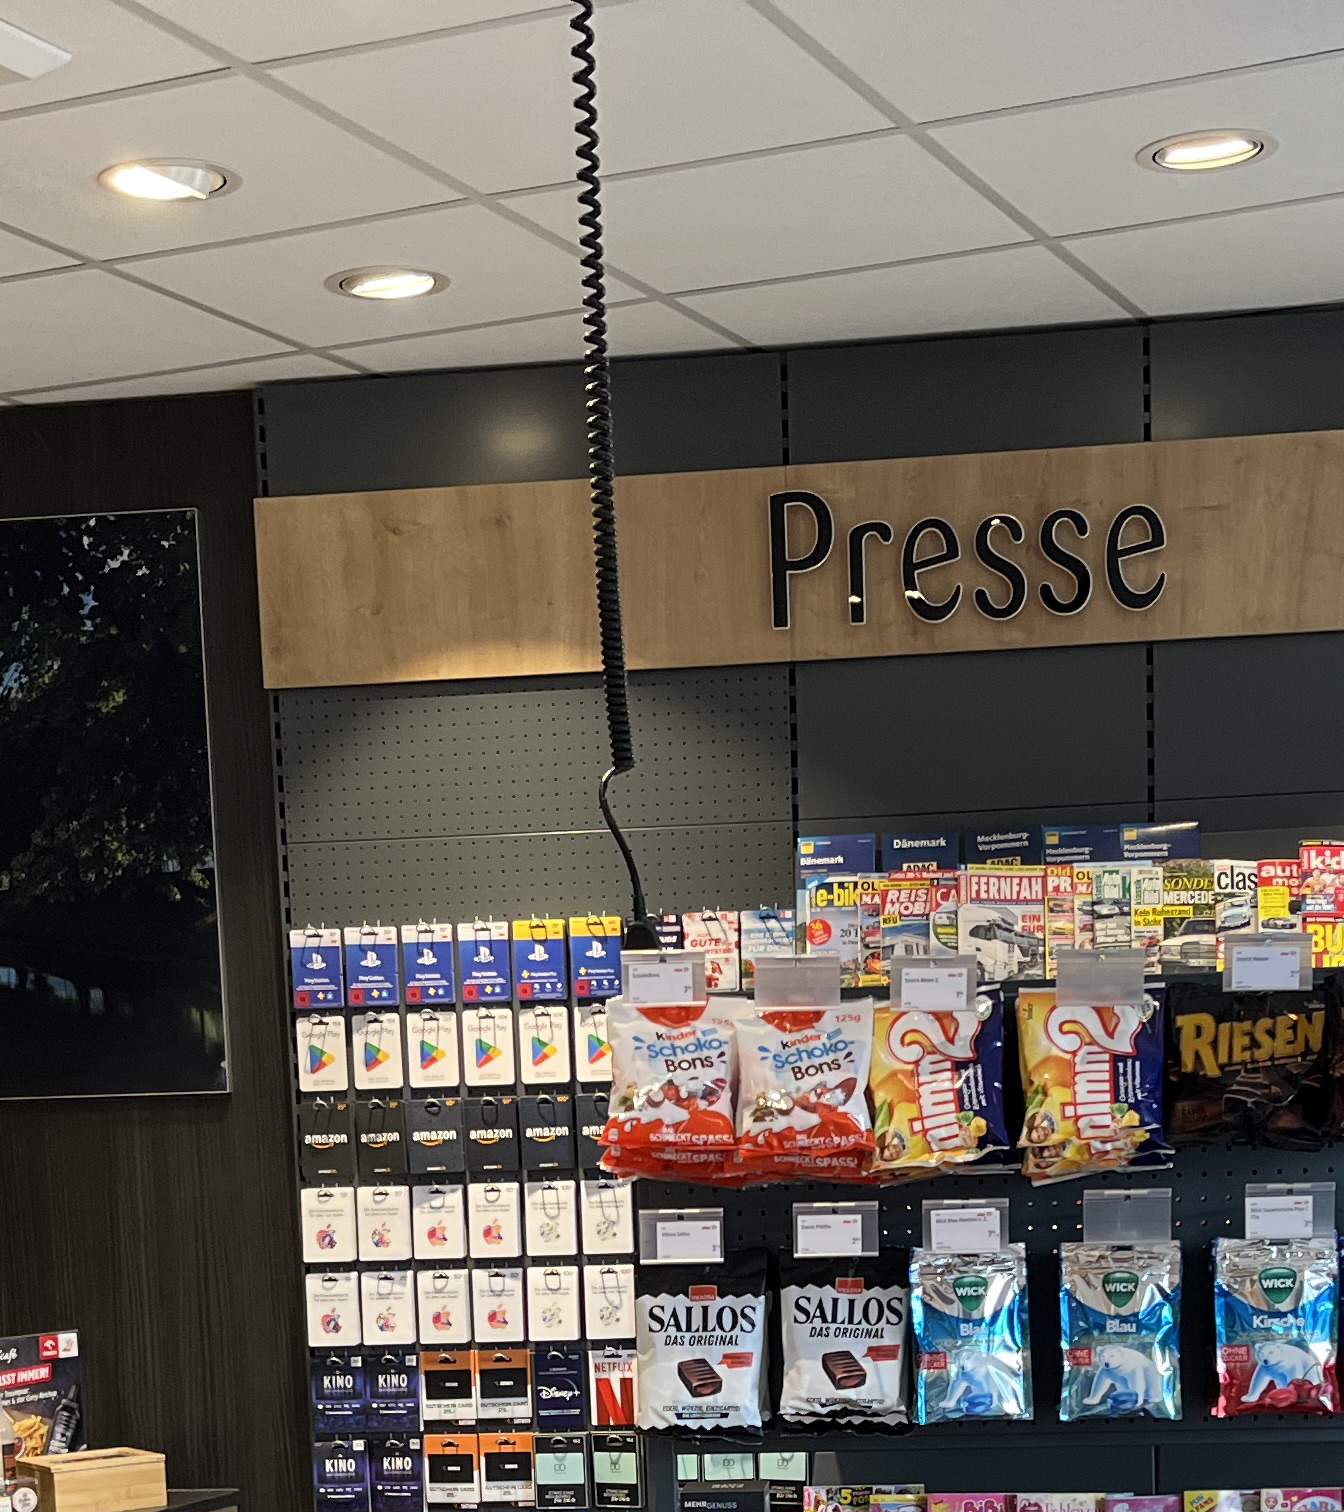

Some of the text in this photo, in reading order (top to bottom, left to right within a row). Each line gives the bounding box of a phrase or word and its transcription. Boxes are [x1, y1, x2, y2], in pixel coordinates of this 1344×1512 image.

[768, 490, 1167, 630] Presse
[893, 837, 946, 849] Dänemark
[977, 831, 1030, 843] Mecklenburg-
[970, 876, 1043, 900] FERNFAH
[1163, 891, 1214, 905] MERCEDE
[882, 917, 899, 925] NEU
[1021, 914, 1041, 923] EIN
[691, 938, 722, 948] GUTE
[835, 1014, 861, 1023] 125g
[655, 1029, 697, 1041] kinder
[780, 1032, 822, 1050] kinder
[646, 1036, 729, 1060] Schoko-
[1175, 1010, 1326, 1078] RIESEN
[772, 1037, 855, 1067] Schoko-
[664, 1055, 715, 1073] Bons
[791, 1058, 842, 1081] Bons
[360, 1131, 400, 1143] amazon
[412, 1130, 457, 1141] amazon
[469, 1127, 513, 1140] amazon
[525, 1126, 569, 1138] amazon
[304, 1133, 348, 1145] amazon
[1105, 1281, 1136, 1293] WICK
[1261, 1278, 1295, 1290] WICK
[955, 1286, 986, 1297] WICK
[793, 1296, 903, 1326] SALLOS
[648, 1305, 756, 1334] SALLOS
[1106, 1319, 1137, 1333] Blau
[1253, 1314, 1306, 1329] Kirsche
[809, 1326, 885, 1339] DAS ORIGINAL
[664, 1335, 739, 1347] DAS ORIGINAL
[595, 1362, 632, 1373] NETFLIX
[17, 1366, 50, 1383] IMMER!
[323, 1374, 353, 1388] KINO
[378, 1373, 408, 1387] KINO
[325, 1458, 356, 1473] KINO
[383, 1456, 412, 1470] KINO
